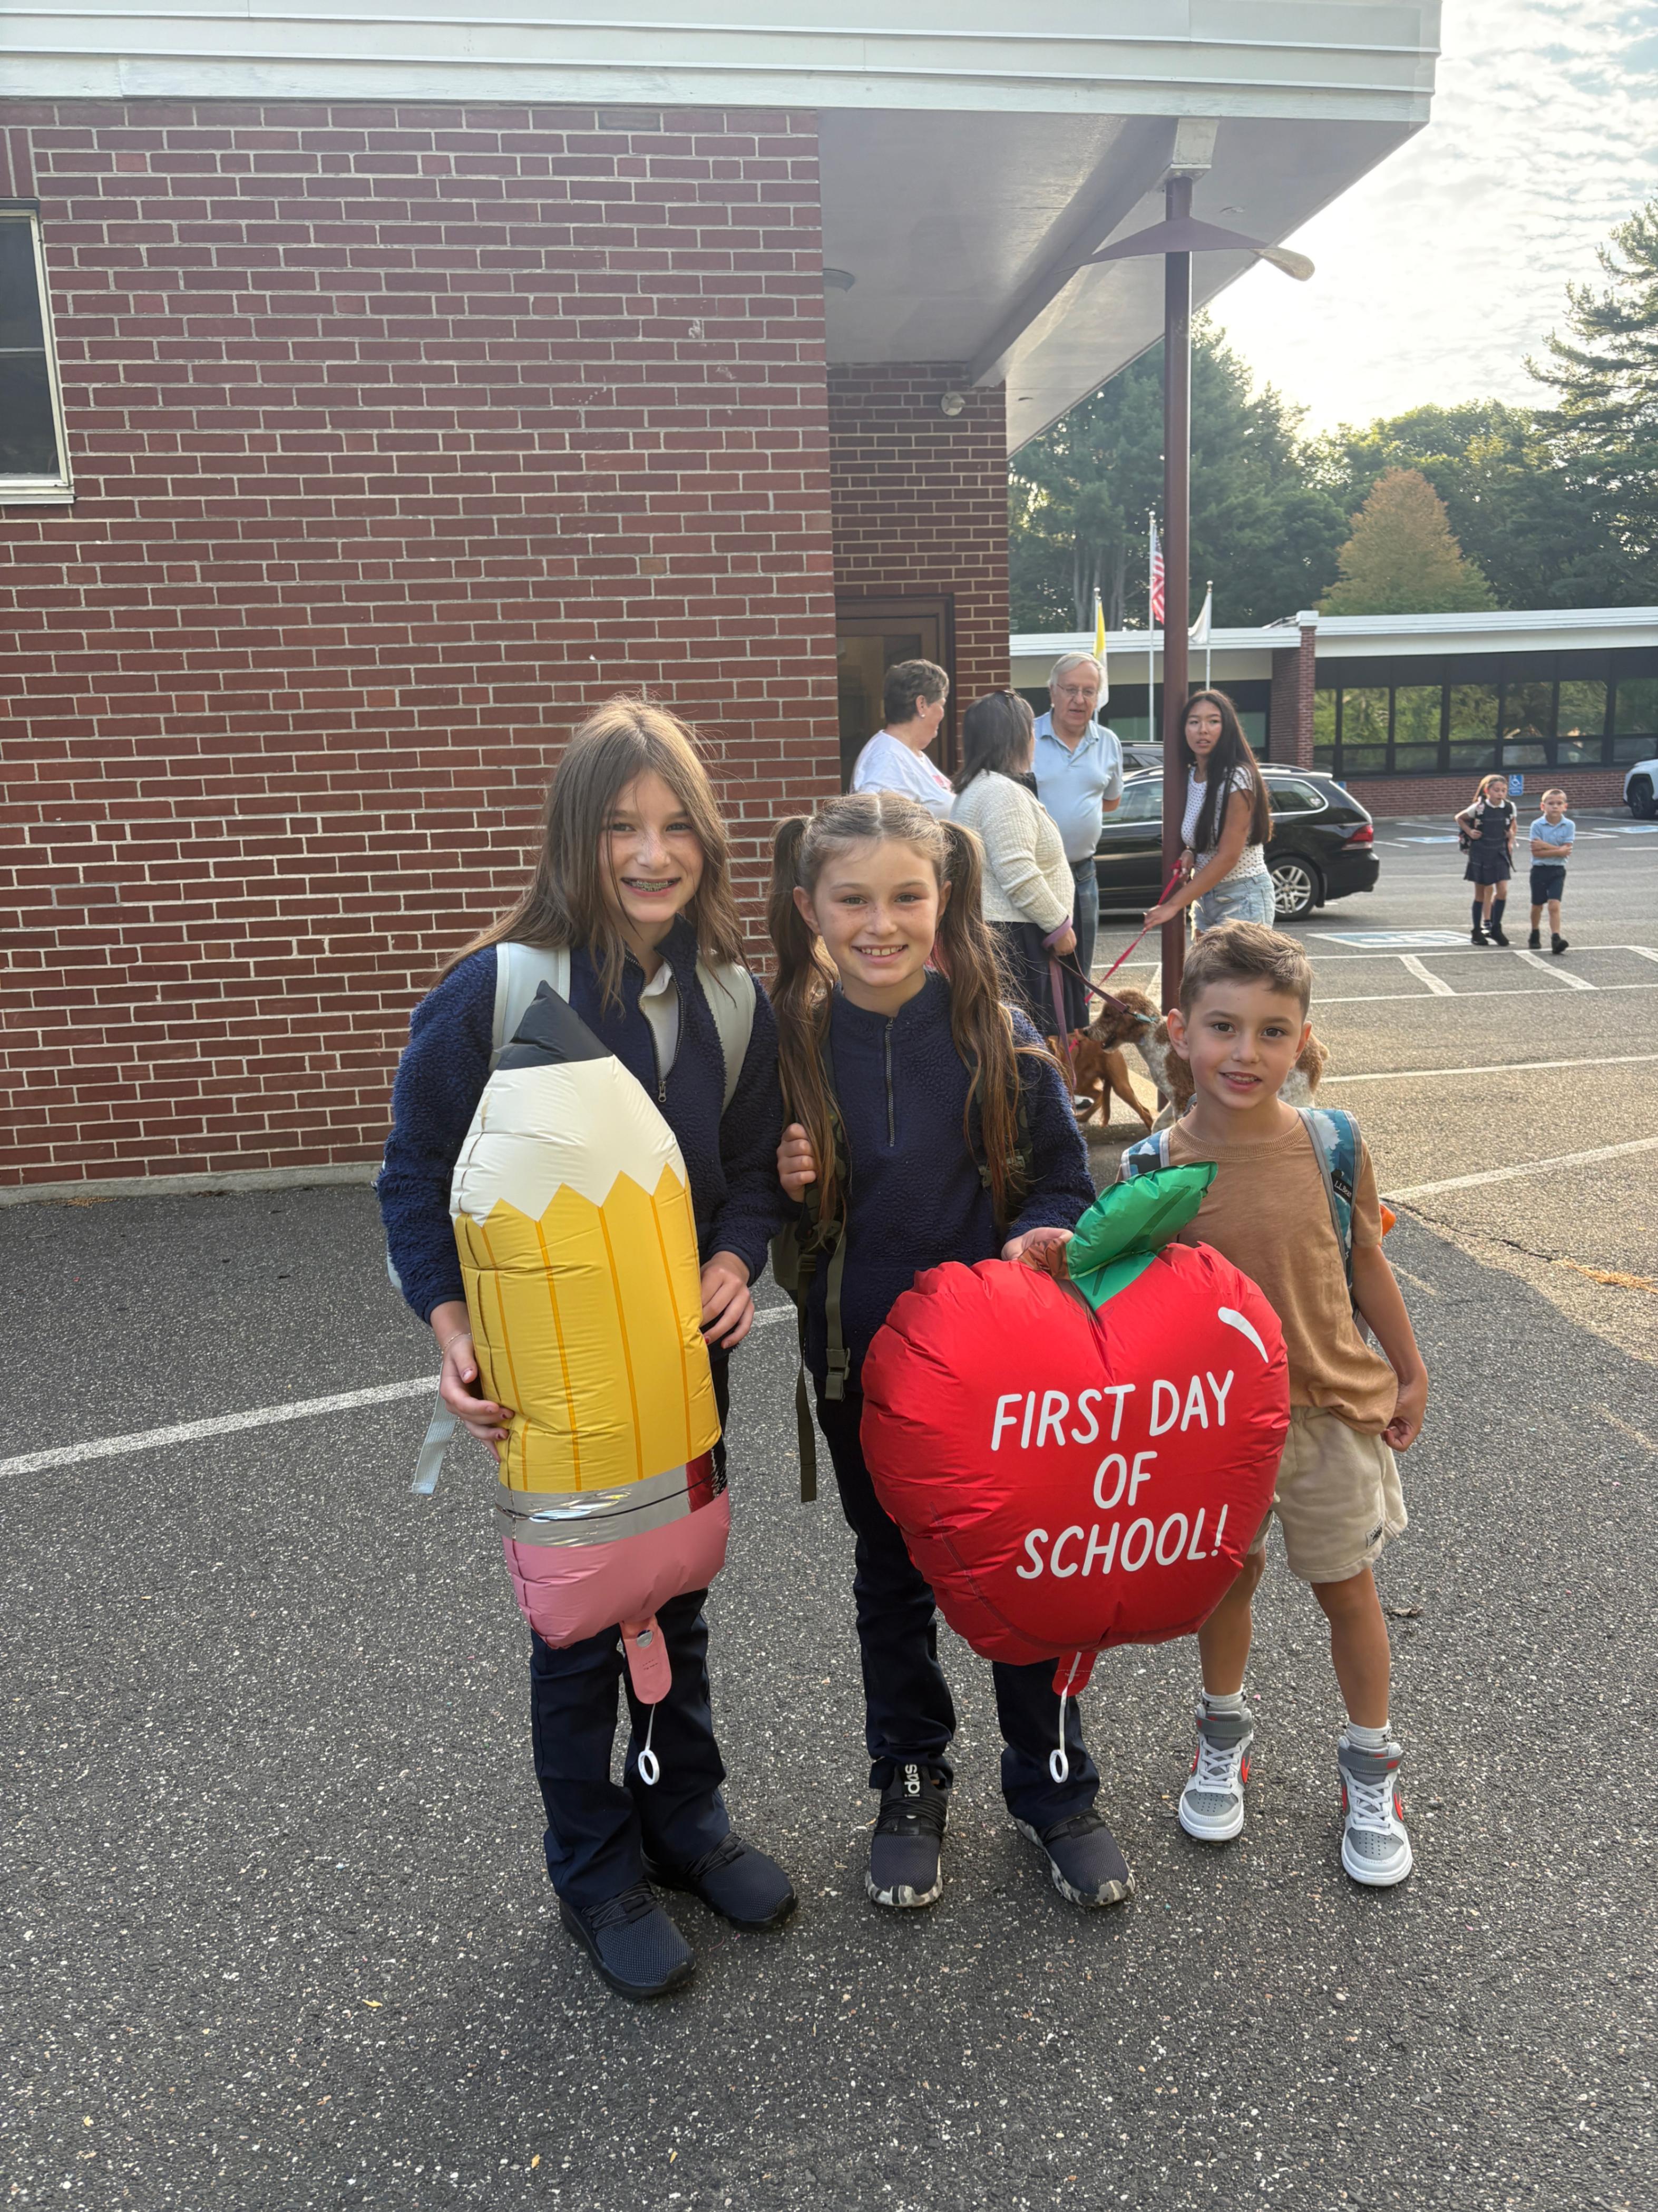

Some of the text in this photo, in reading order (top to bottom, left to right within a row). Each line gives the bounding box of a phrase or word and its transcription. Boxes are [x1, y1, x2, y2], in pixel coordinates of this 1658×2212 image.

[991, 1369, 1234, 1451] FIRST DAY
[1093, 1450, 1158, 1509] OF
[1016, 1504, 1229, 1579] SCHOOL!
[904, 1763, 920, 1819] idas
